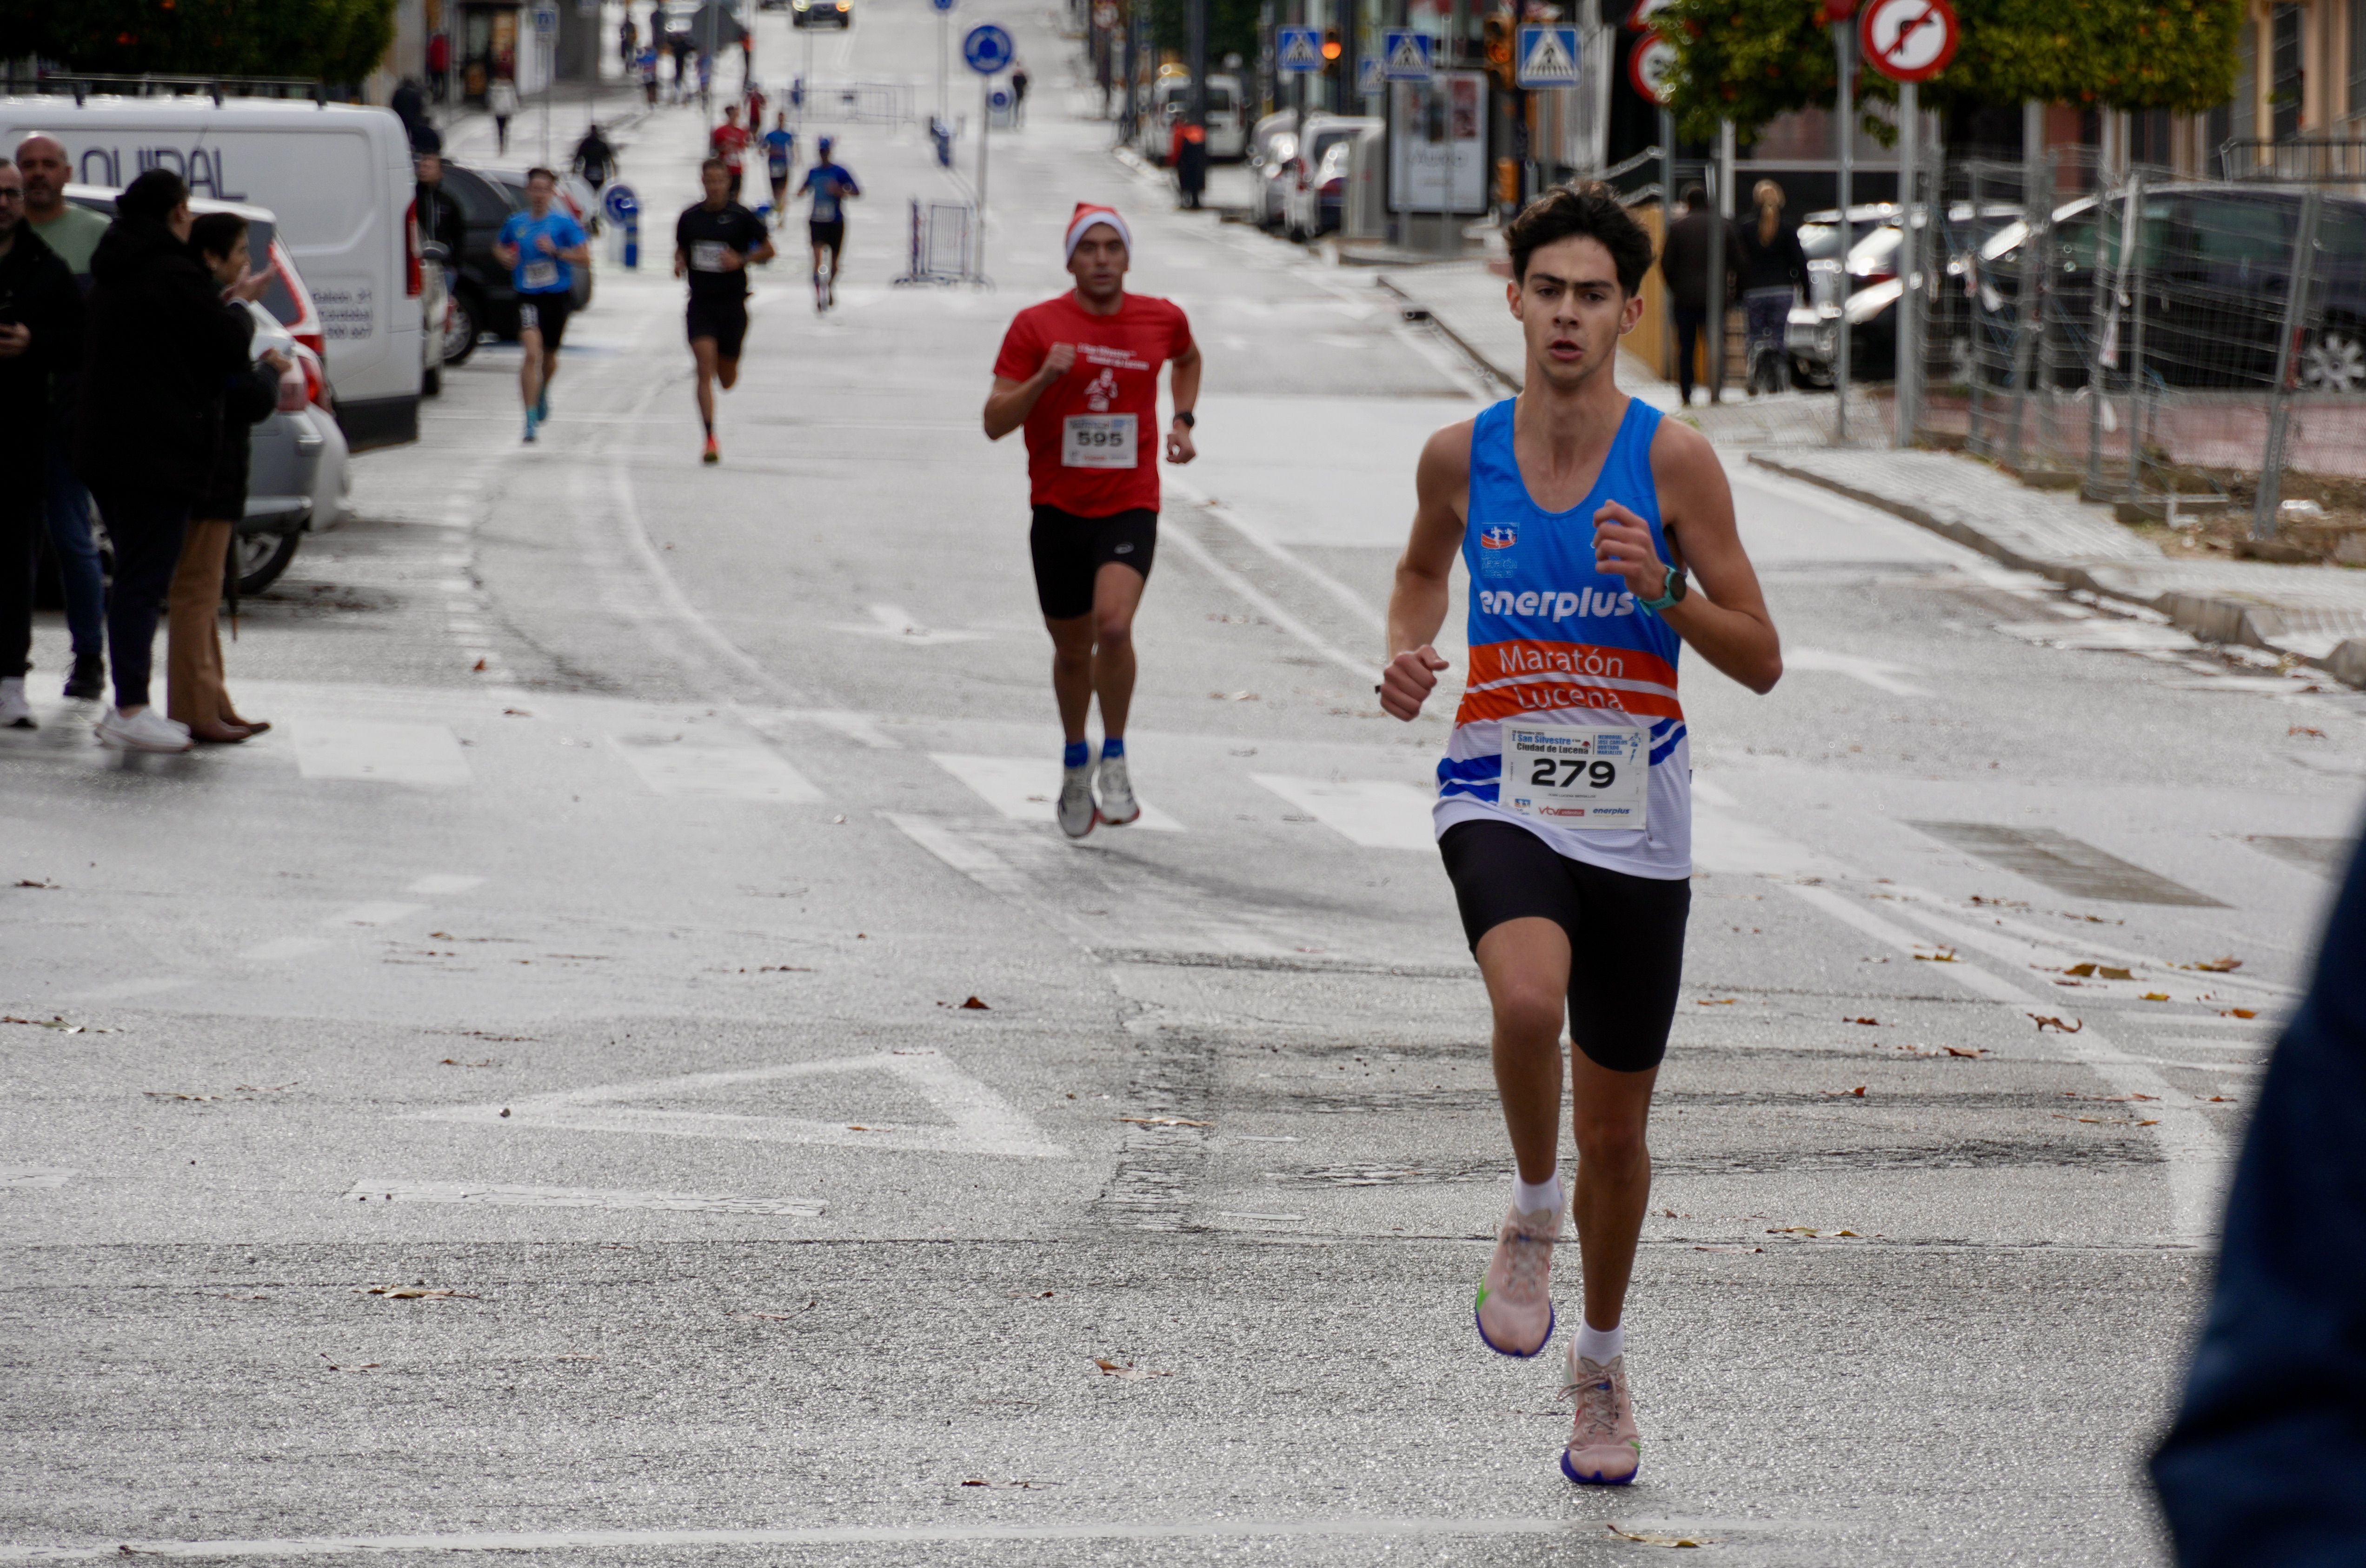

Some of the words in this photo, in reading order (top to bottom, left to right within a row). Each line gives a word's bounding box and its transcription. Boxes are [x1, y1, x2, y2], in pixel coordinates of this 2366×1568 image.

[1077, 432, 1124, 447] 595
[1480, 587, 1634, 623] enerplus
[1499, 645, 1623, 677] Maratón
[1513, 686, 1623, 711] Lucena
[1516, 743, 1544, 752] Ciudad
[1559, 745, 1588, 754] Lucena
[1535, 735, 1571, 745] Silvestre
[1531, 758, 1615, 789] 279
